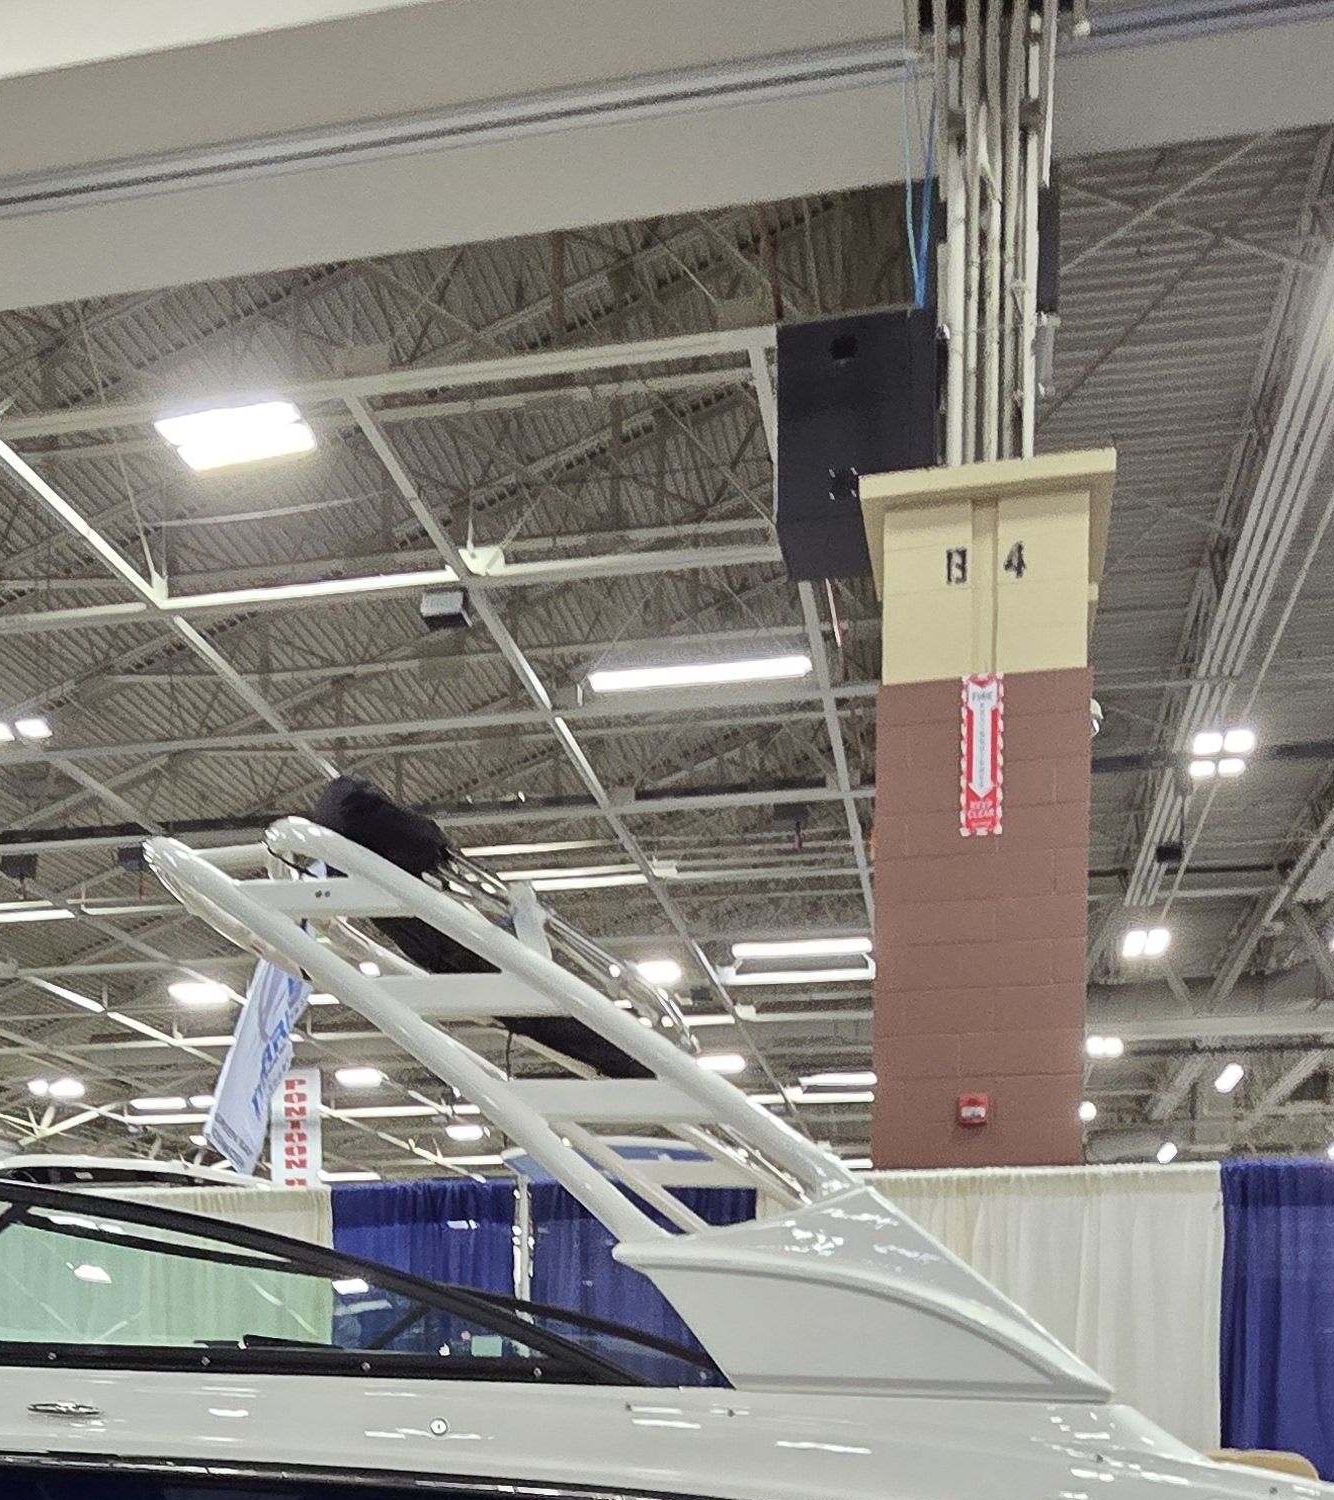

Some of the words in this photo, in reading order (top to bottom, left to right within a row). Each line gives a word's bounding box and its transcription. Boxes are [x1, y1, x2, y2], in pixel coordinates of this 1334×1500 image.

[1003, 541, 1026, 578] 4
[971, 691, 994, 702] FIRE
[969, 799, 993, 810] KEEP
[967, 807, 995, 820] CLEAR
[283, 1078, 308, 1170] PONTOON
